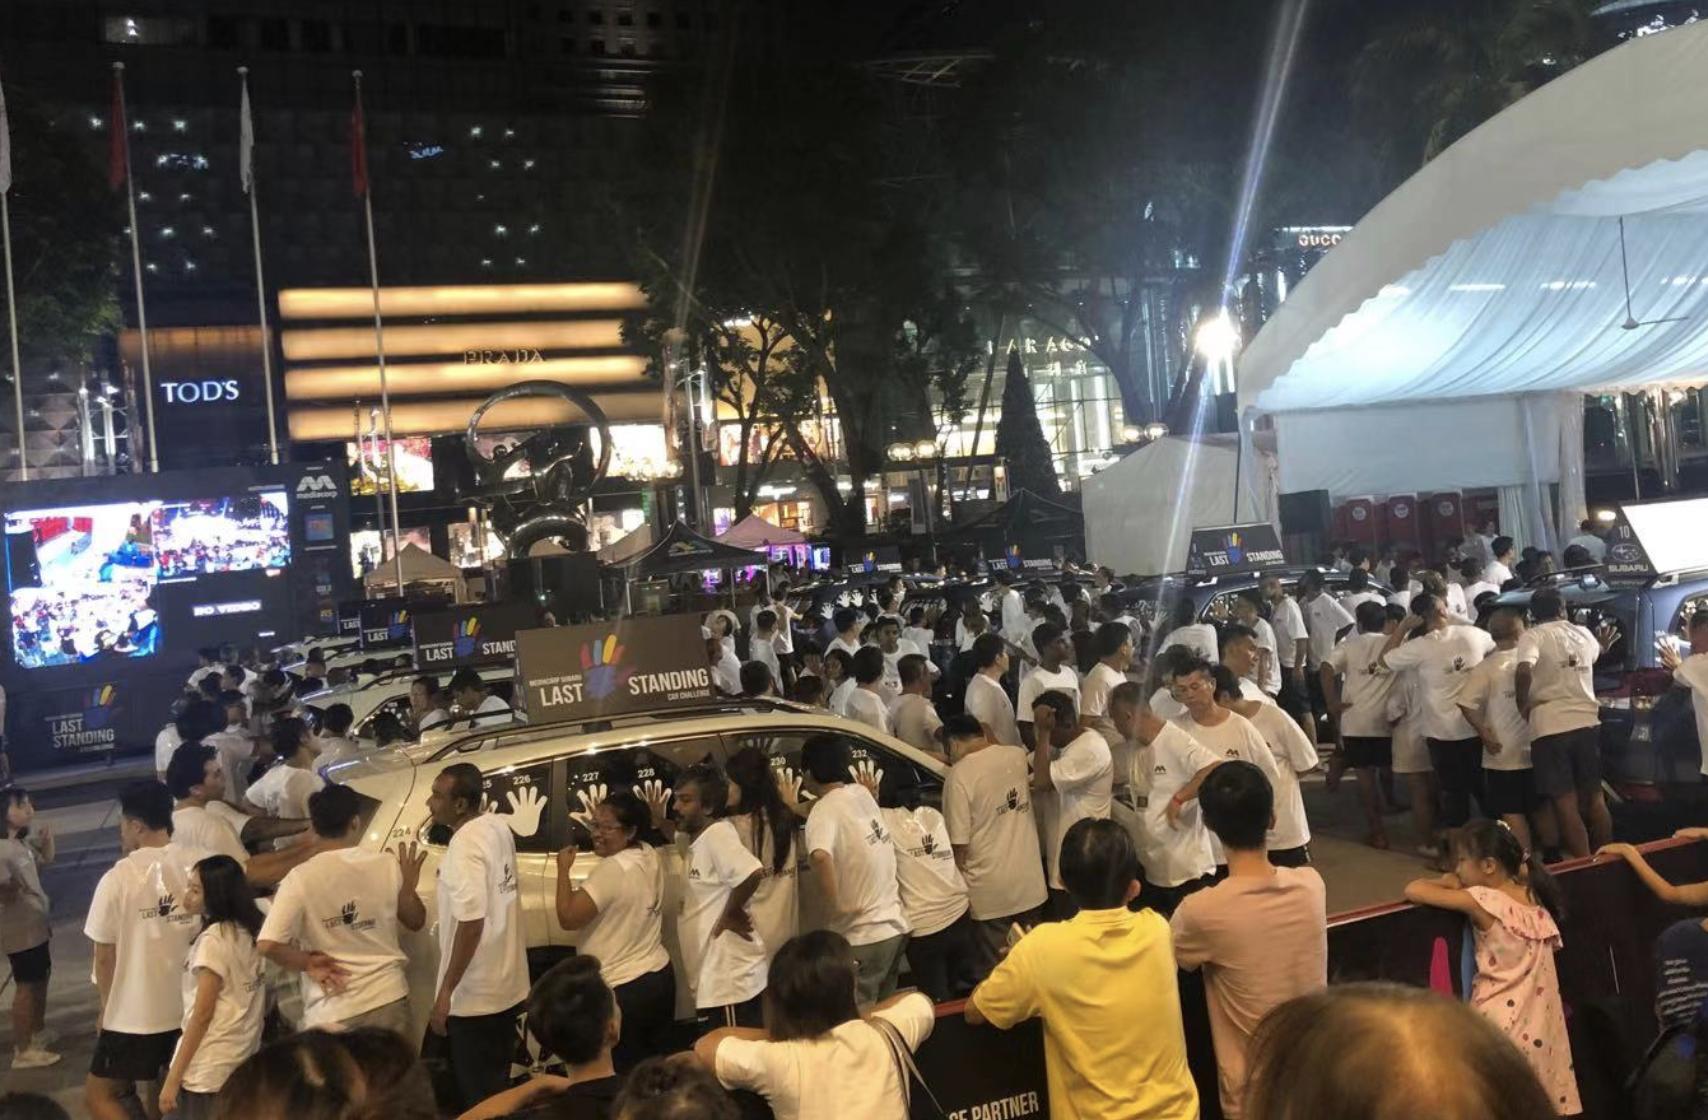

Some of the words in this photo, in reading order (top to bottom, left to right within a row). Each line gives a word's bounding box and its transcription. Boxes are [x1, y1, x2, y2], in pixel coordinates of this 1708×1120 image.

[463, 348, 545, 365] PRADA
[159, 379, 240, 403] TOD'S
[1618, 525, 1630, 539] 10
[1208, 554, 1230, 566] LAST
[1246, 549, 1284, 562] STANDING
[1608, 564, 1649, 573] SUBARU
[367, 631, 389, 642] LAST
[426, 646, 454, 661] LAST
[540, 683, 583, 706] LAST
[628, 668, 709, 695] STANDING
[52, 718, 83, 735] LAST
[53, 728, 115, 749] STANDING
[513, 775, 531, 785] 226
[582, 770, 600, 782] 227
[637, 768, 655, 778] 228
[971, 1091, 1040, 1120] PARTNER
